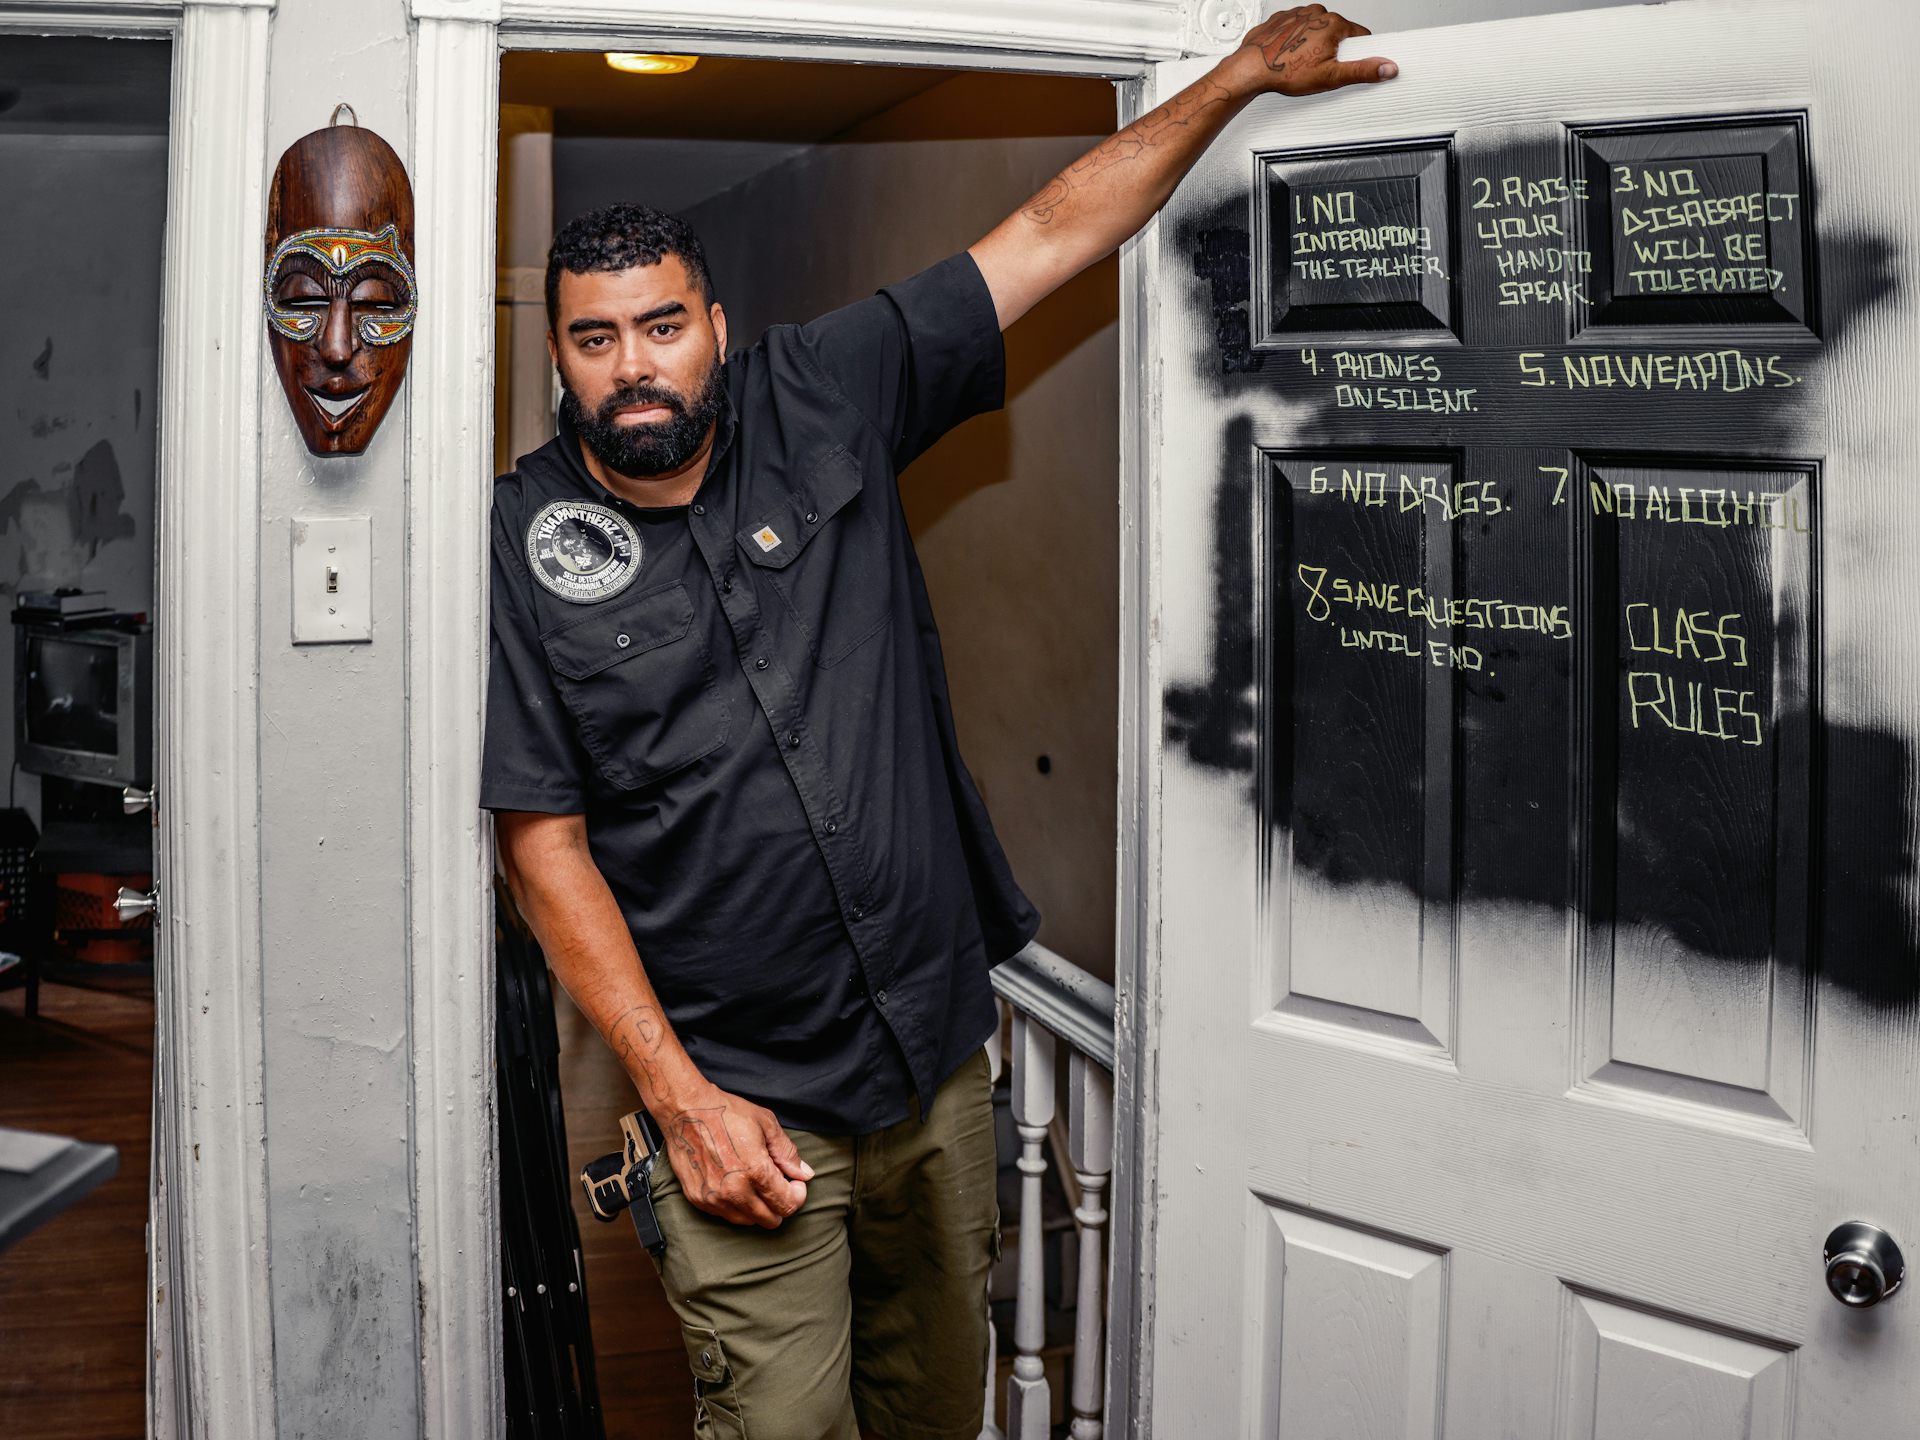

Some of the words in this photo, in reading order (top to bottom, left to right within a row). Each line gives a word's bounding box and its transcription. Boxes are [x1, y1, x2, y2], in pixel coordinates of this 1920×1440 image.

[1502, 176, 1589, 207] RAISE
[1643, 168, 1700, 197] NO
[1312, 191, 1356, 224] NO
[1622, 193, 1799, 237] DISRESPECT
[1477, 213, 1564, 249] YOUR
[1496, 247, 1562, 277] HAND
[1562, 250, 1592, 273] TO
[1633, 236, 1715, 264] WILL
[1723, 233, 1767, 262] BE
[1292, 258, 1340, 280] THE
[1340, 253, 1451, 280] TEACHER.
[1628, 267, 1787, 293] TOLERATED.
[1498, 280, 1594, 305] SPEAK.
[1301, 349, 1325, 376] 4.
[1332, 350, 1442, 382] PHONES
[1519, 352, 1555, 386] 5.
[1335, 384, 1373, 409] ON
[1377, 387, 1479, 414] SILENT.
[1342, 468, 1387, 507] NO
[1399, 474, 1511, 522] DRUGS.
[1538, 465, 1568, 506] 7.
[1590, 481, 1636, 520] NO
[1646, 485, 1810, 533] ALCOHOL
[538, 519, 558, 540] THA
[557, 508, 621, 535] PANTHERZ
[1333, 578, 1404, 614] SAVE
[1407, 587, 1573, 639] QUESTIONS
[1626, 603, 1748, 666] CLASS
[1341, 627, 1421, 657] UNTIL
[1428, 639, 1496, 678] END.
[1628, 671, 1763, 746] RULES
